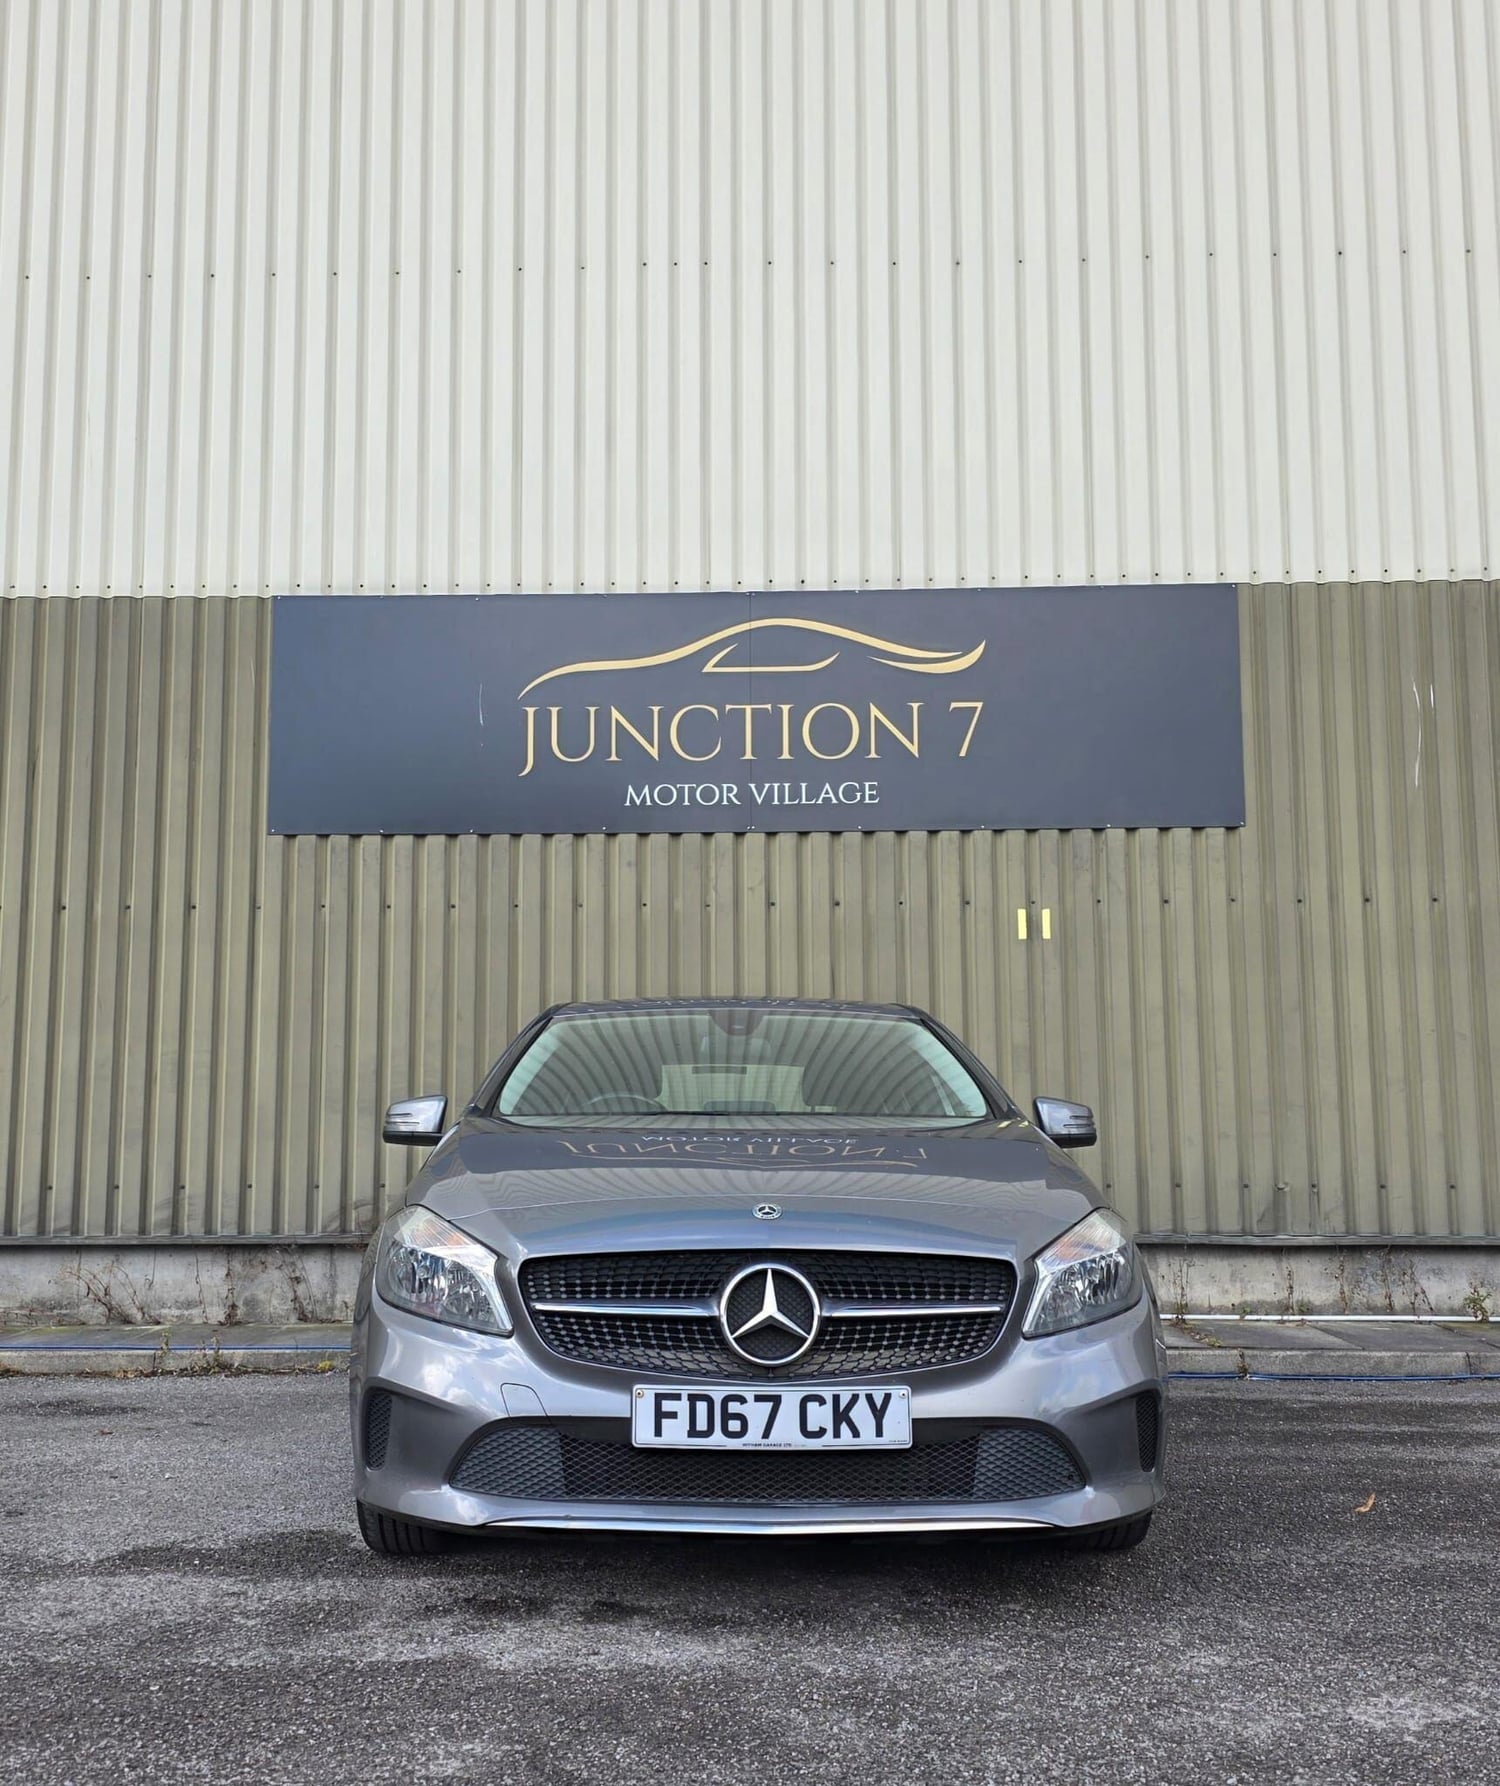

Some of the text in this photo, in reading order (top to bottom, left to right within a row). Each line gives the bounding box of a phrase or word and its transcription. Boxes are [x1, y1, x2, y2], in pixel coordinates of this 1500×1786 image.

[518, 701, 984, 777] JUNCTION 7
[624, 781, 880, 807] MOTOR VILLAGE
[654, 1392, 893, 1440] FD67 CKY
